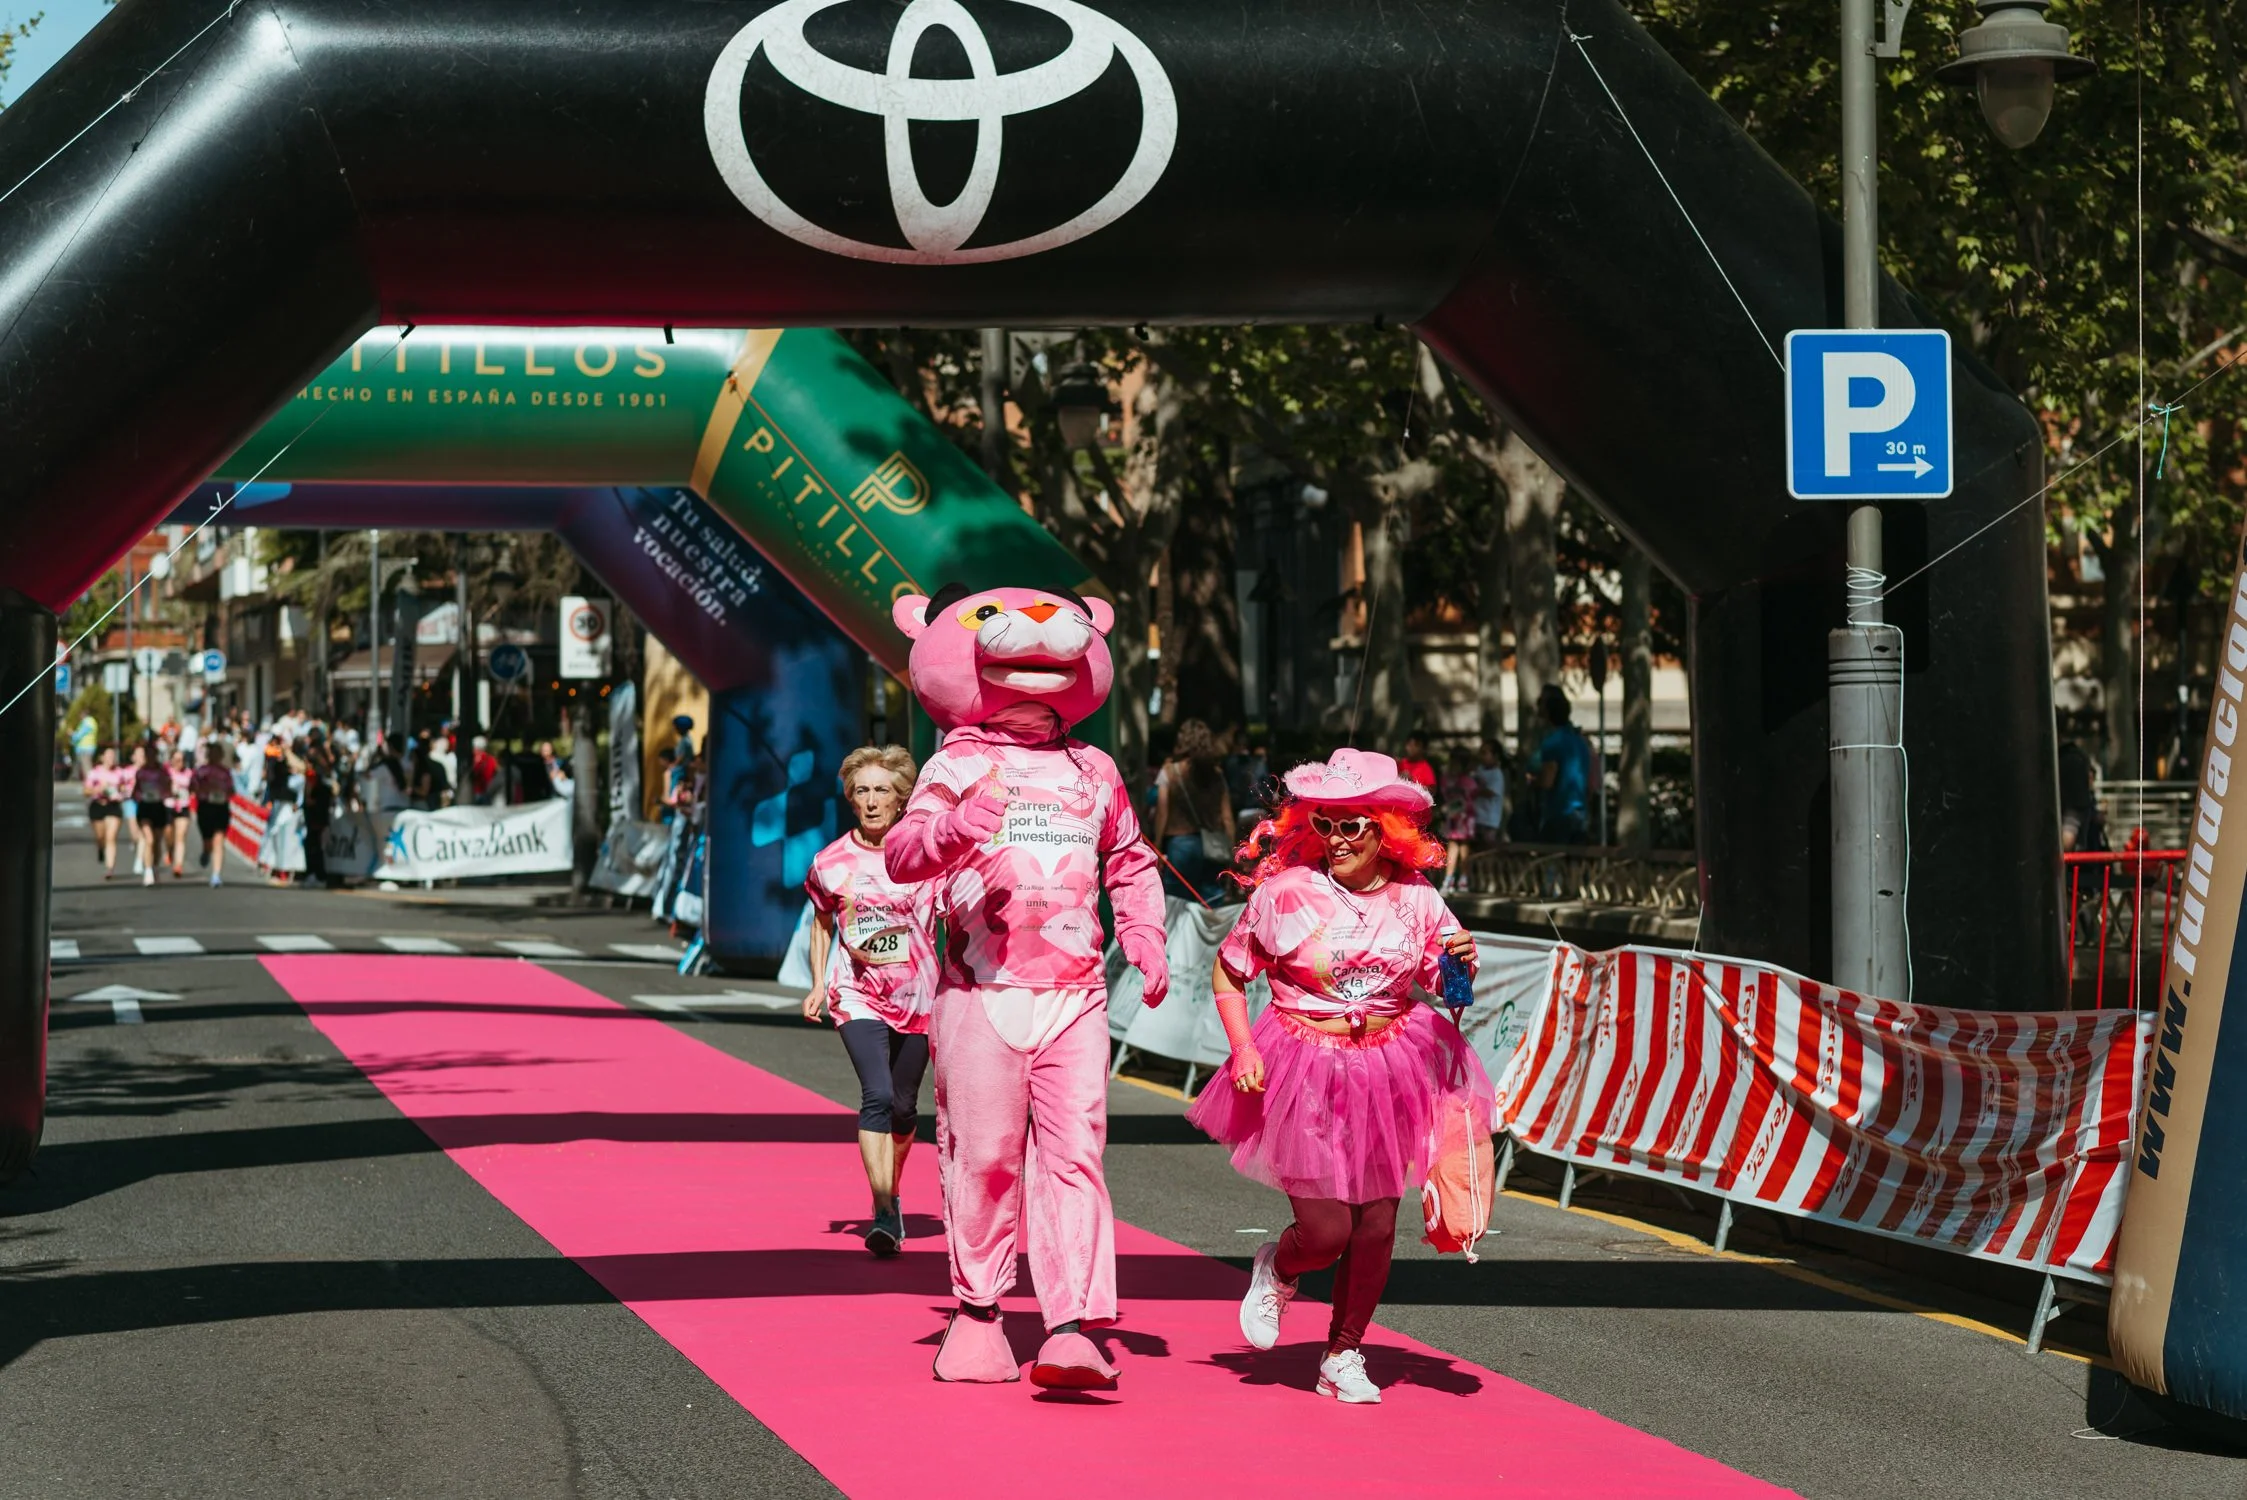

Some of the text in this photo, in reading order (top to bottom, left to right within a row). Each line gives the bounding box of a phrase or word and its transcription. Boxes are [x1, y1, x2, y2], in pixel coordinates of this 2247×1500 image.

[296, 386, 667, 408] HECHO EN ESPAÑA DESDE 1981
[1822, 351, 1917, 477] P
[1885, 441, 1926, 455] 30 m
[670, 490, 763, 594] Tu salud,
[652, 513, 747, 607] nuestra
[633, 526, 727, 627] vocación.
[1007, 786, 1021, 797] XI
[1008, 800, 1062, 812] Carrera
[1008, 815, 1048, 829] por la
[412, 820, 549, 862] CaixaBank
[1009, 830, 1095, 846] Investigación
[855, 904, 894, 913] Carrera
[857, 914, 886, 926] por la
[1331, 949, 1345, 962] XI
[1332, 964, 1381, 979] Carrera
[1350, 976, 1364, 988] la
